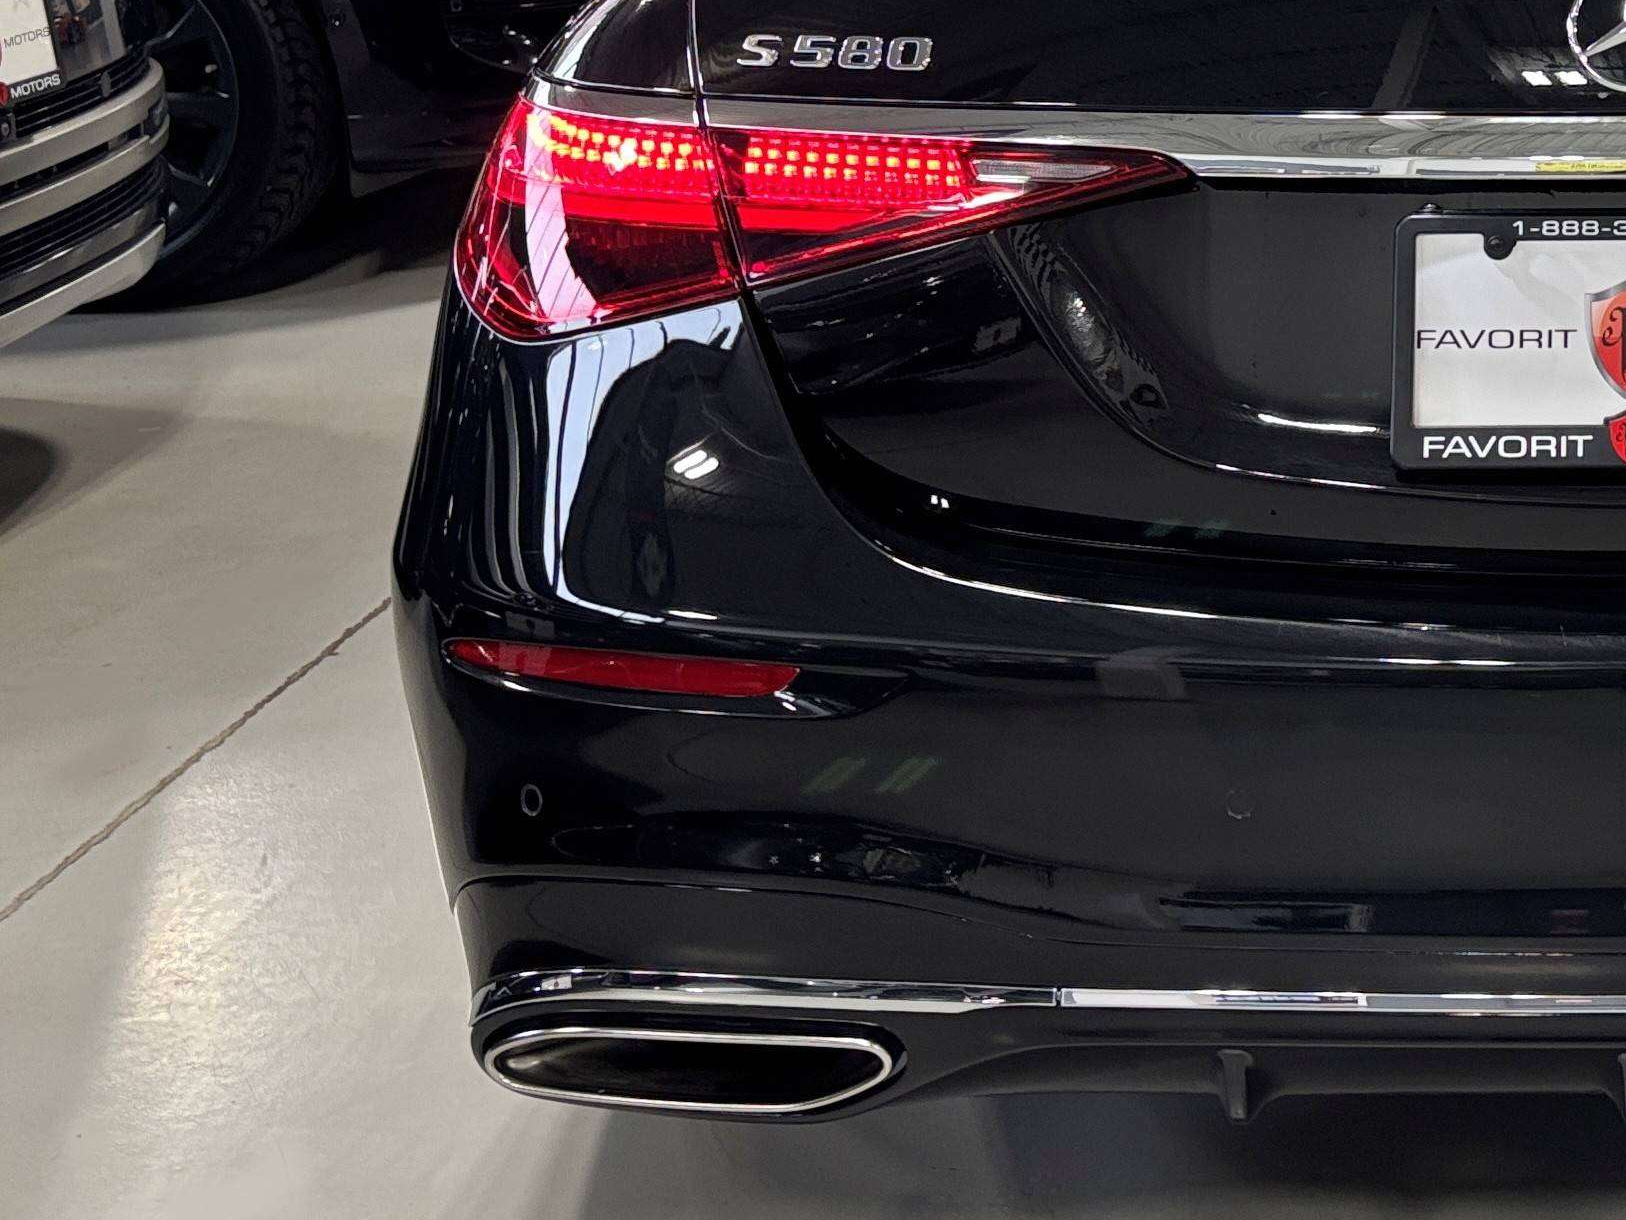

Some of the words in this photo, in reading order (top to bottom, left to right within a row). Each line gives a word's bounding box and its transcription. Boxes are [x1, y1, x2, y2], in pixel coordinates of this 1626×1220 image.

[4, 26, 51, 50] MOTORS
[736, 34, 783, 67] S
[790, 34, 933, 71] 580
[10, 73, 61, 100] MOTORS
[1416, 328, 1578, 350] FAVORIT
[1422, 434, 1594, 459] FAVORIT
